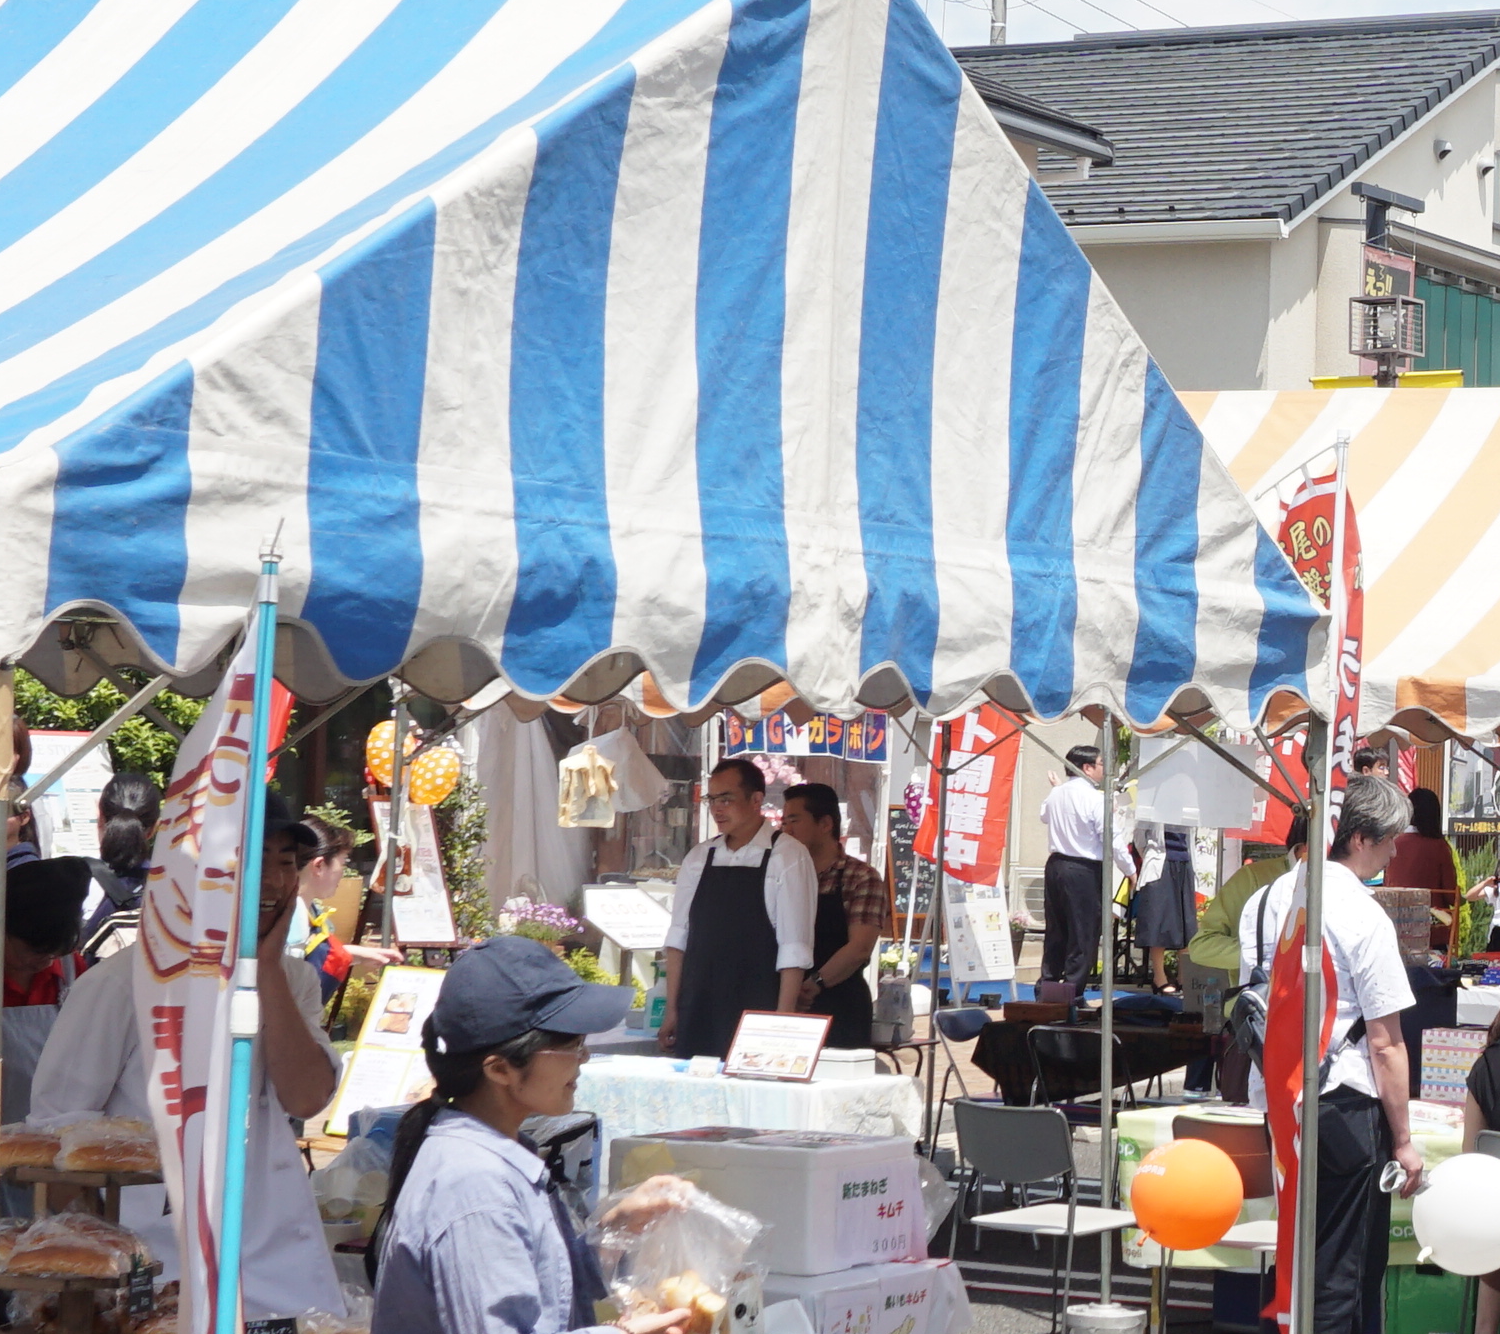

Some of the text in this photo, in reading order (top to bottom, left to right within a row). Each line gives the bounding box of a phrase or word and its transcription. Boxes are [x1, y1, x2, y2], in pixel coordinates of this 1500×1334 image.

[1280, 515, 1332, 563] 尾の
[842, 1177, 888, 1200] 新たまねぎ
[877, 1200, 904, 1219] キムチ
[872, 1234, 907, 1254] 300円
[884, 1288, 927, 1312] 長いもキムチ
